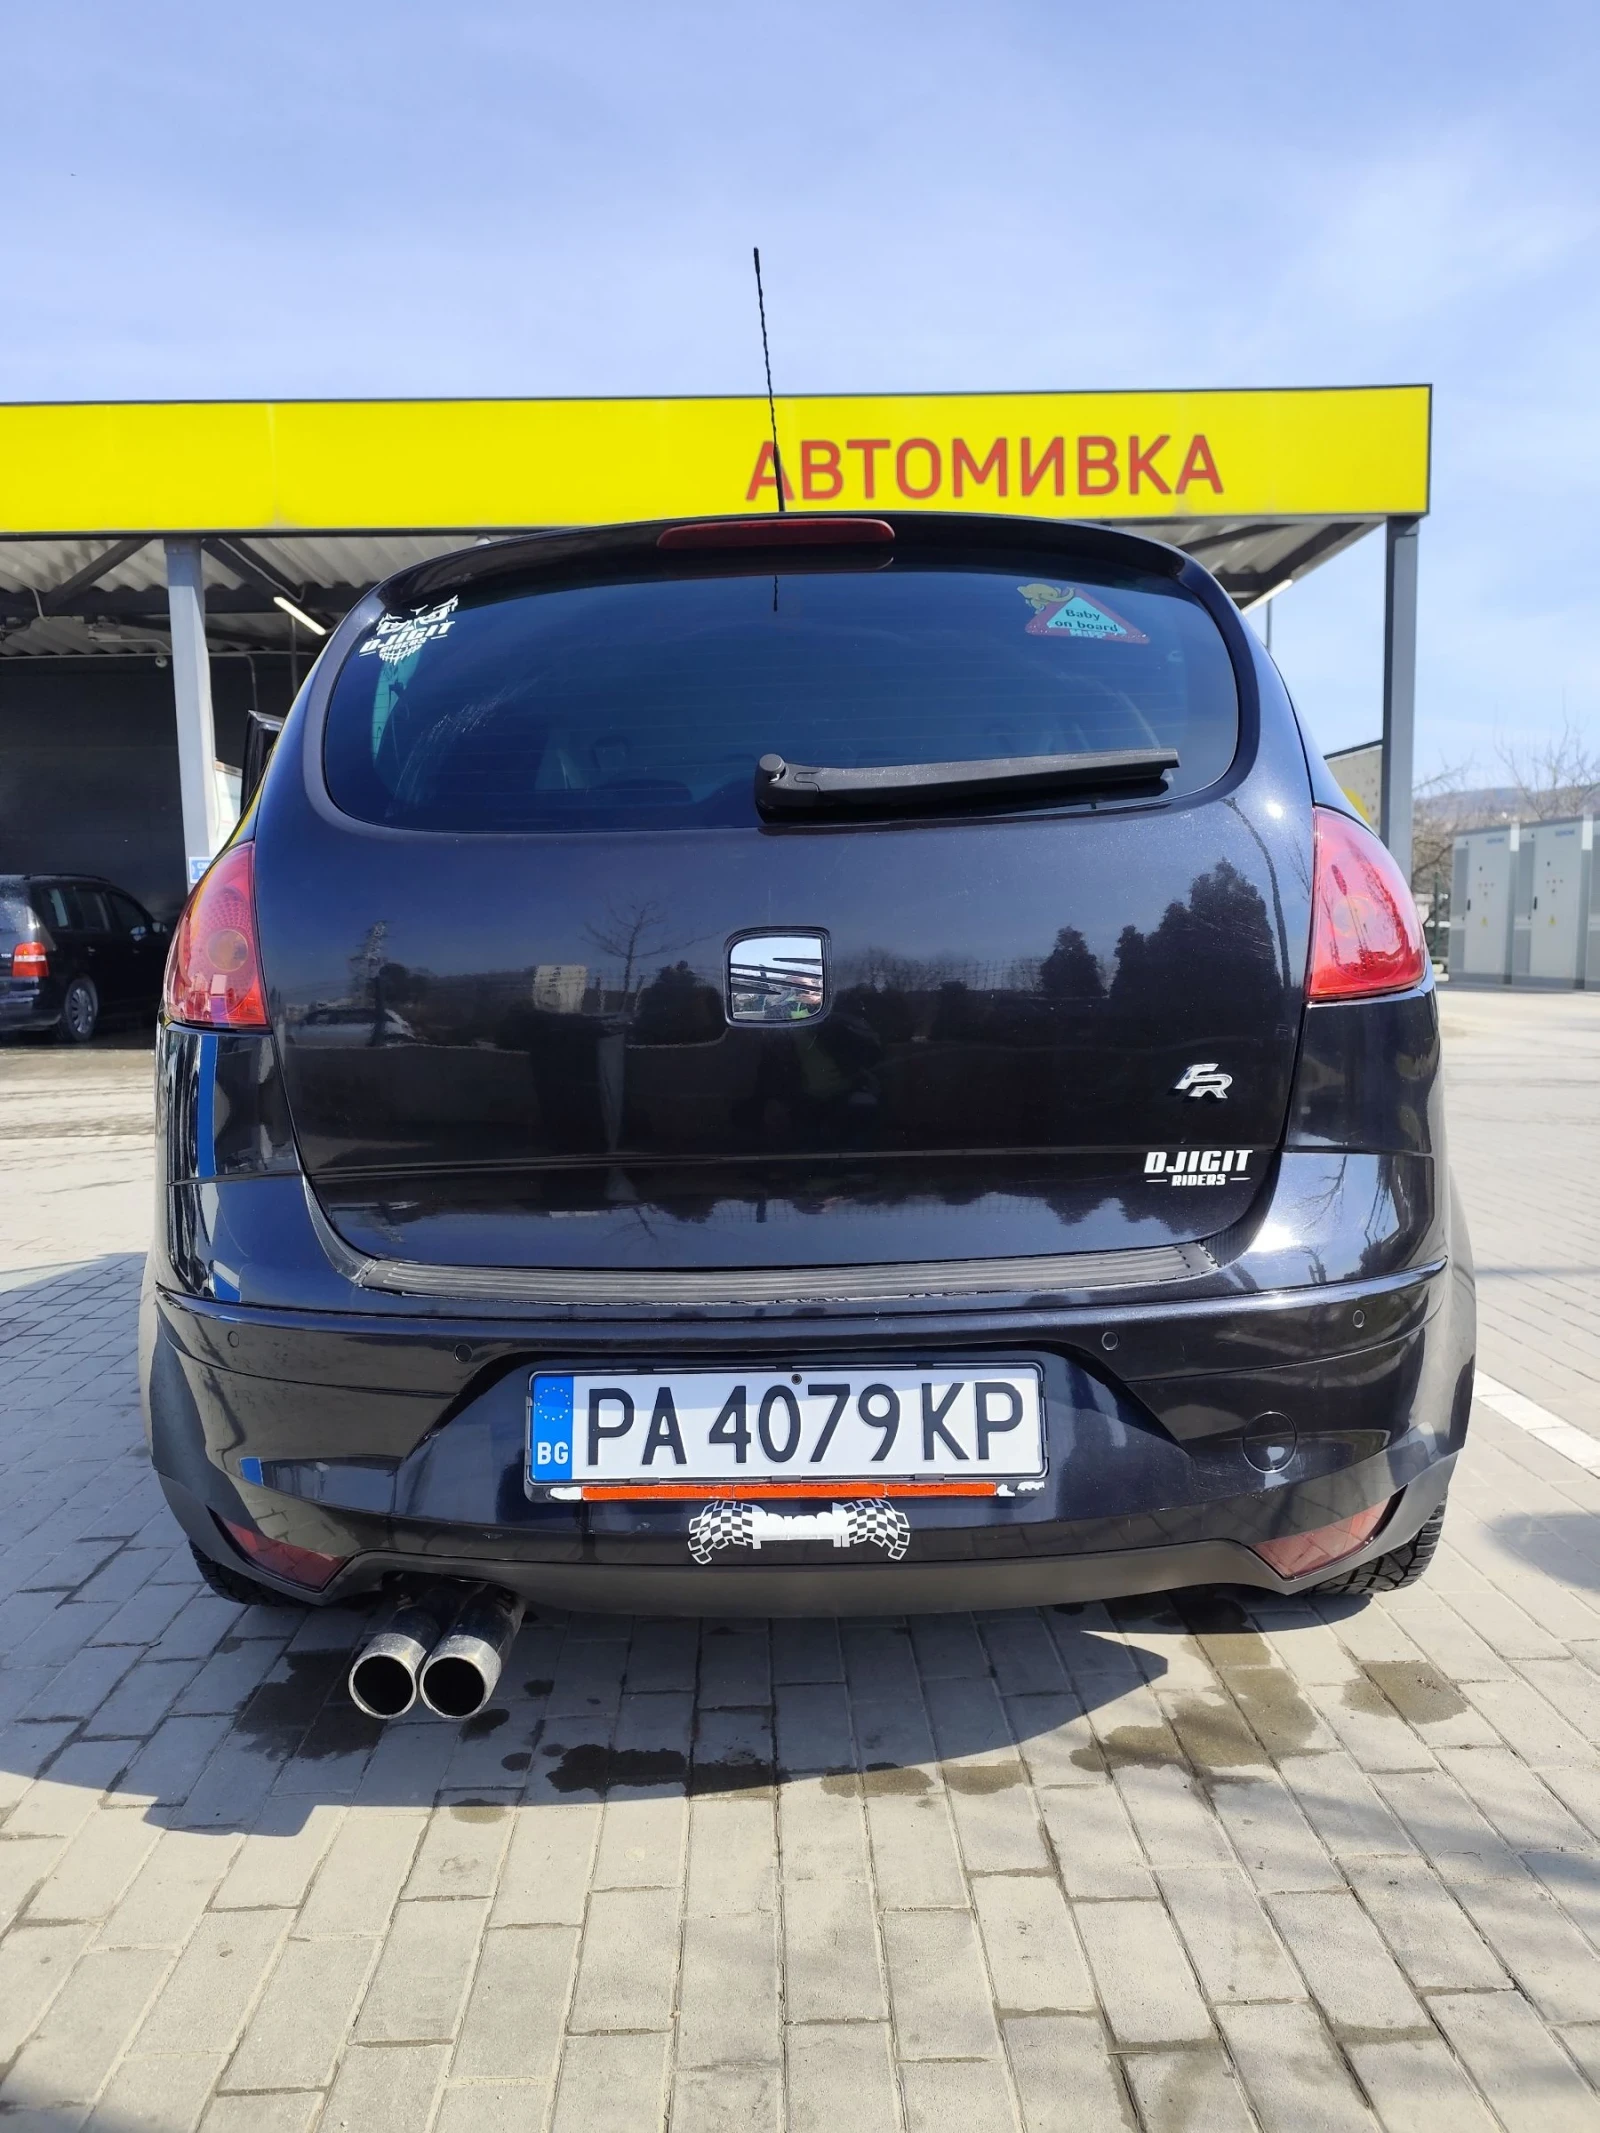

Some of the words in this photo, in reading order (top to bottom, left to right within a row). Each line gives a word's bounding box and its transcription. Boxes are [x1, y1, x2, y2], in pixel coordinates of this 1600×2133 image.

[746, 434, 1224, 501] АВТОМИВКА
[1065, 609, 1100, 621] Baby
[1077, 621, 1118, 632] board
[359, 620, 456, 654] DJIGIT
[1174, 1063, 1233, 1099] FR
[1143, 1149, 1254, 1174] DJIGIT
[1171, 1173, 1227, 1187] RIDERS
[588, 1386, 688, 1466] PA
[708, 1384, 902, 1463] 4079
[920, 1381, 1024, 1461] KP
[537, 1441, 569, 1465] BG
